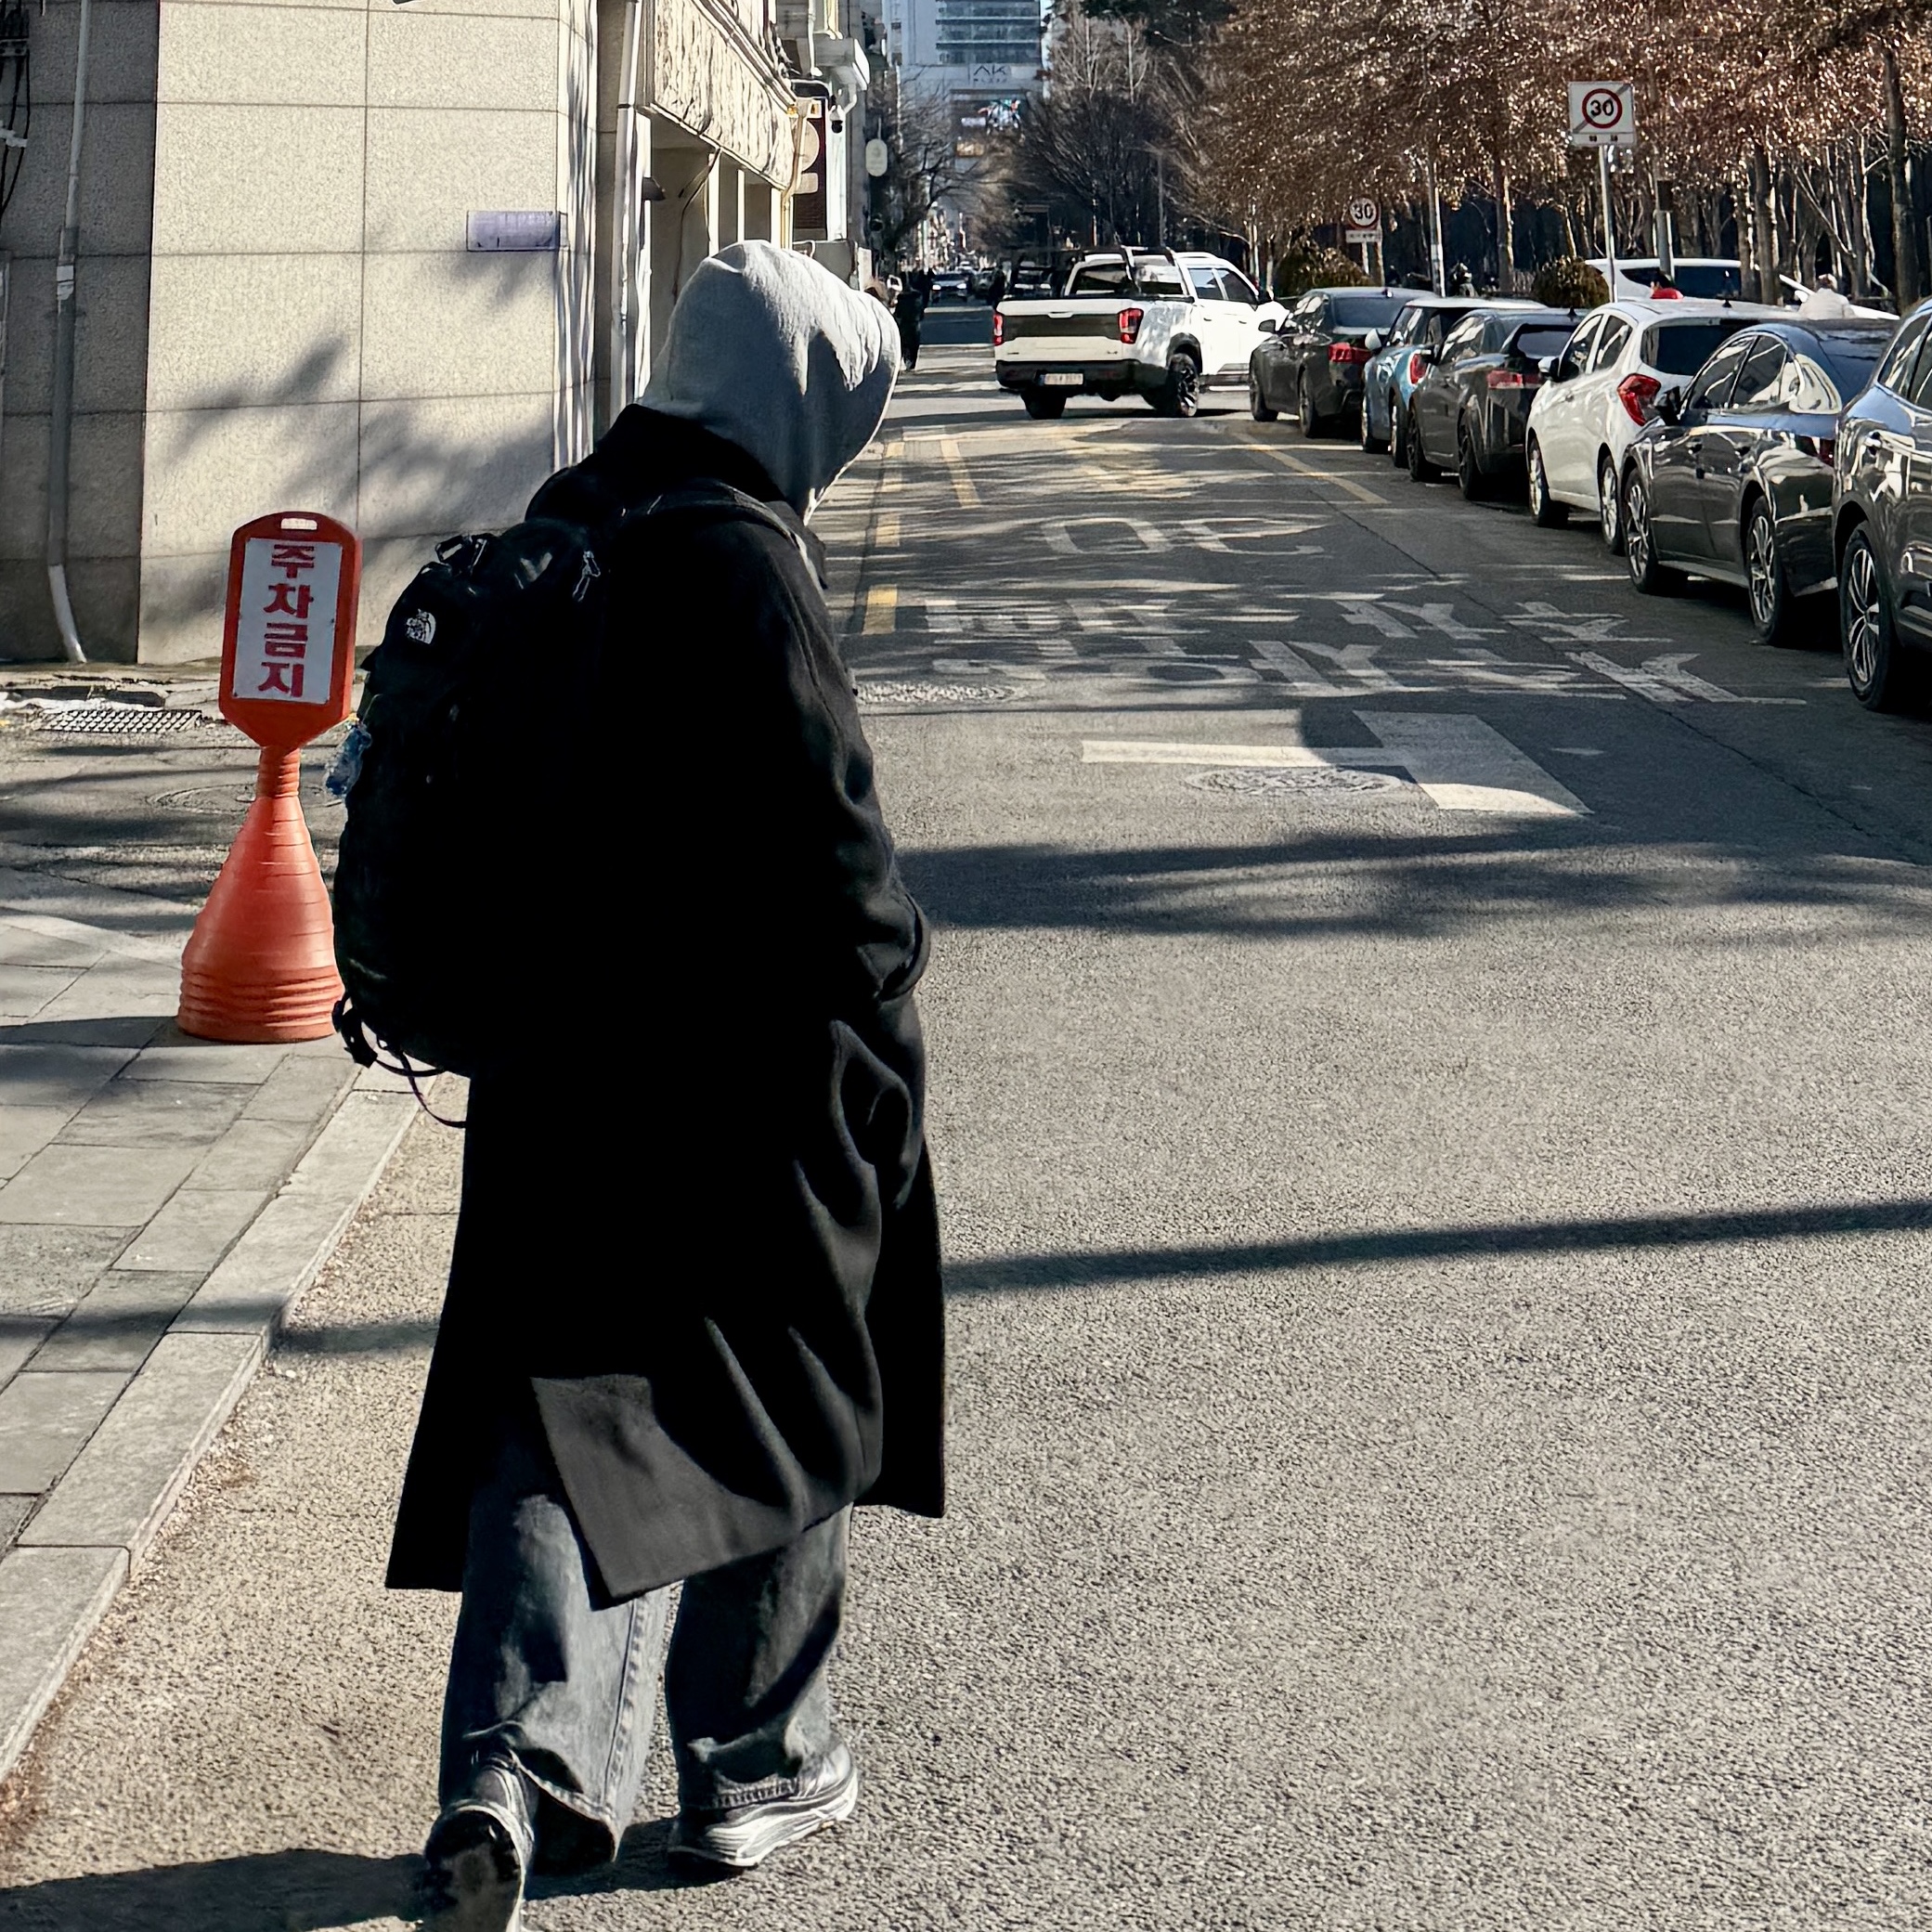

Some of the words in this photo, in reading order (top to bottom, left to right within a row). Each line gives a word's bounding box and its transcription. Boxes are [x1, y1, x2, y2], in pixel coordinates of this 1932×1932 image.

[974, 65, 1006, 75] AK
[1590, 99, 1614, 117] 30
[1353, 202, 1373, 219] 30
[257, 544, 315, 697] 주차금지
